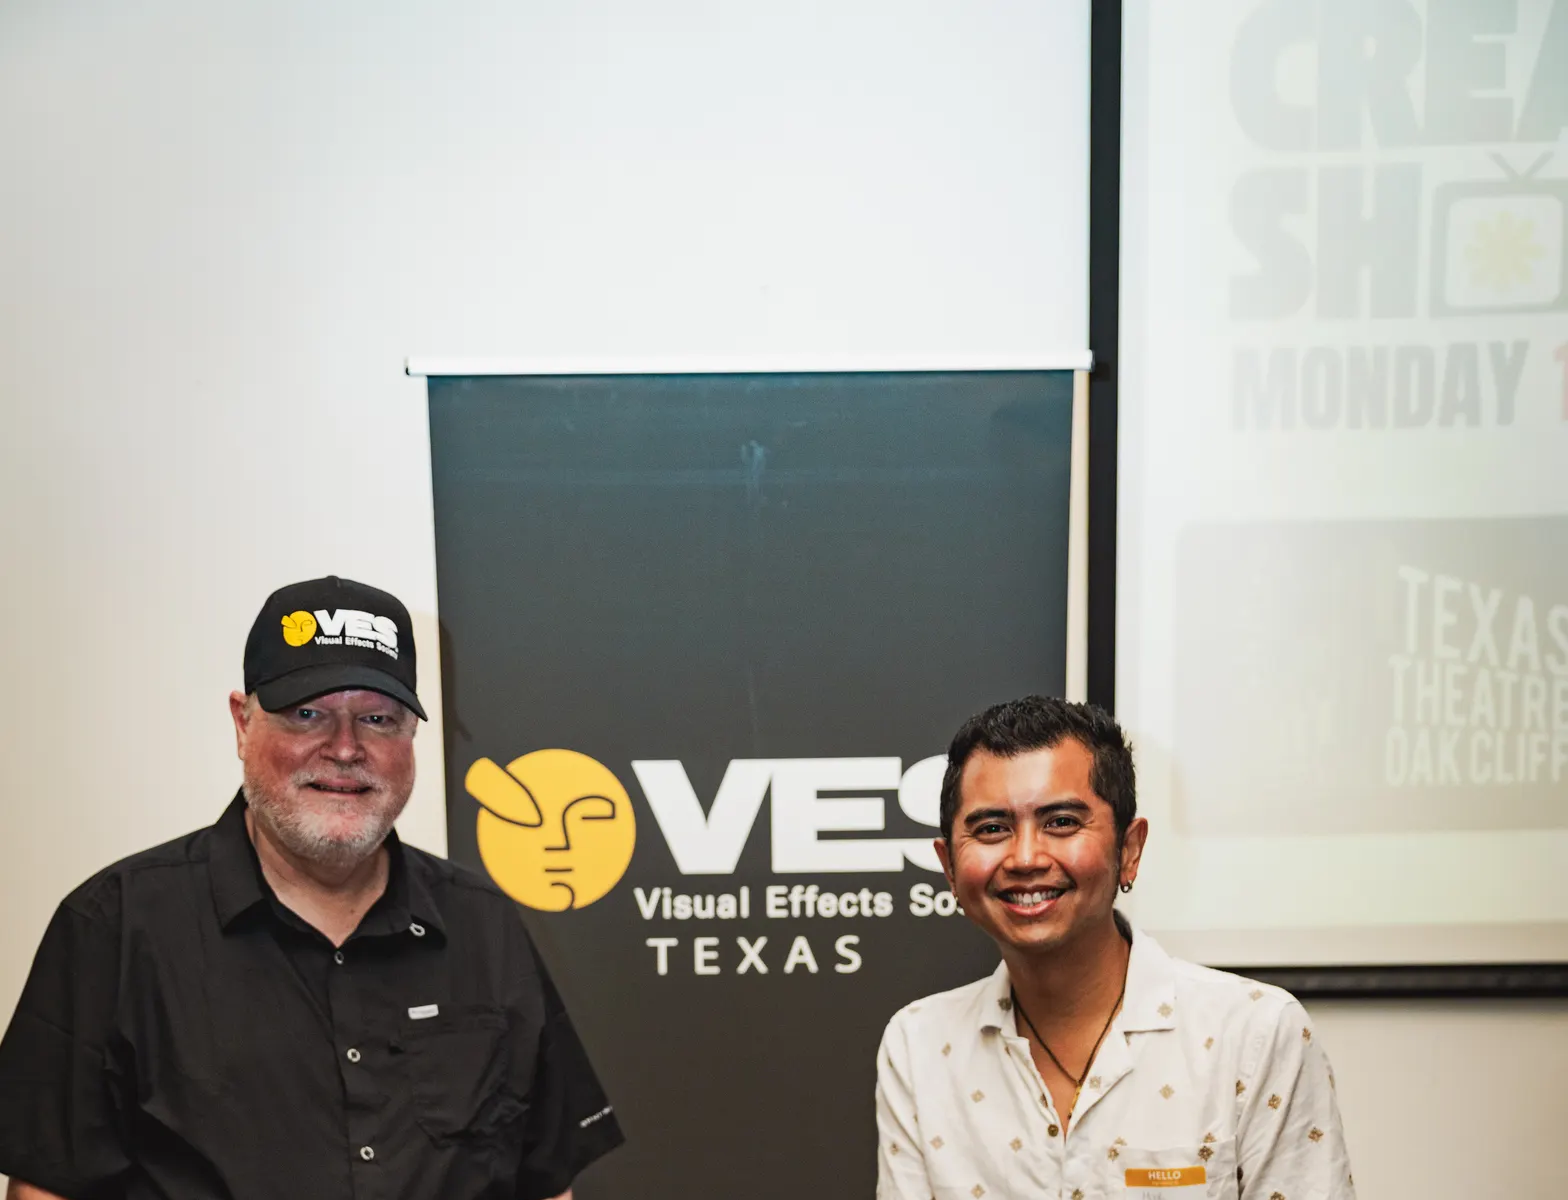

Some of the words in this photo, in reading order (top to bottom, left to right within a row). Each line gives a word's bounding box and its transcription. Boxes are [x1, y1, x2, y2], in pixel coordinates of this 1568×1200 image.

[1231, 339, 1530, 432] MONDAY
[313, 608, 398, 649] VES
[314, 636, 342, 645] Visual
[1398, 564, 1568, 676] TEXAS
[1388, 654, 1568, 733] THEATRE
[1385, 728, 1463, 787] OAK
[1469, 729, 1568, 786] CLIFF
[634, 886, 750, 920] Visual
[765, 884, 893, 919] Effects
[645, 934, 863, 976] TEXAS
[1148, 1170, 1181, 1180] HELLO
